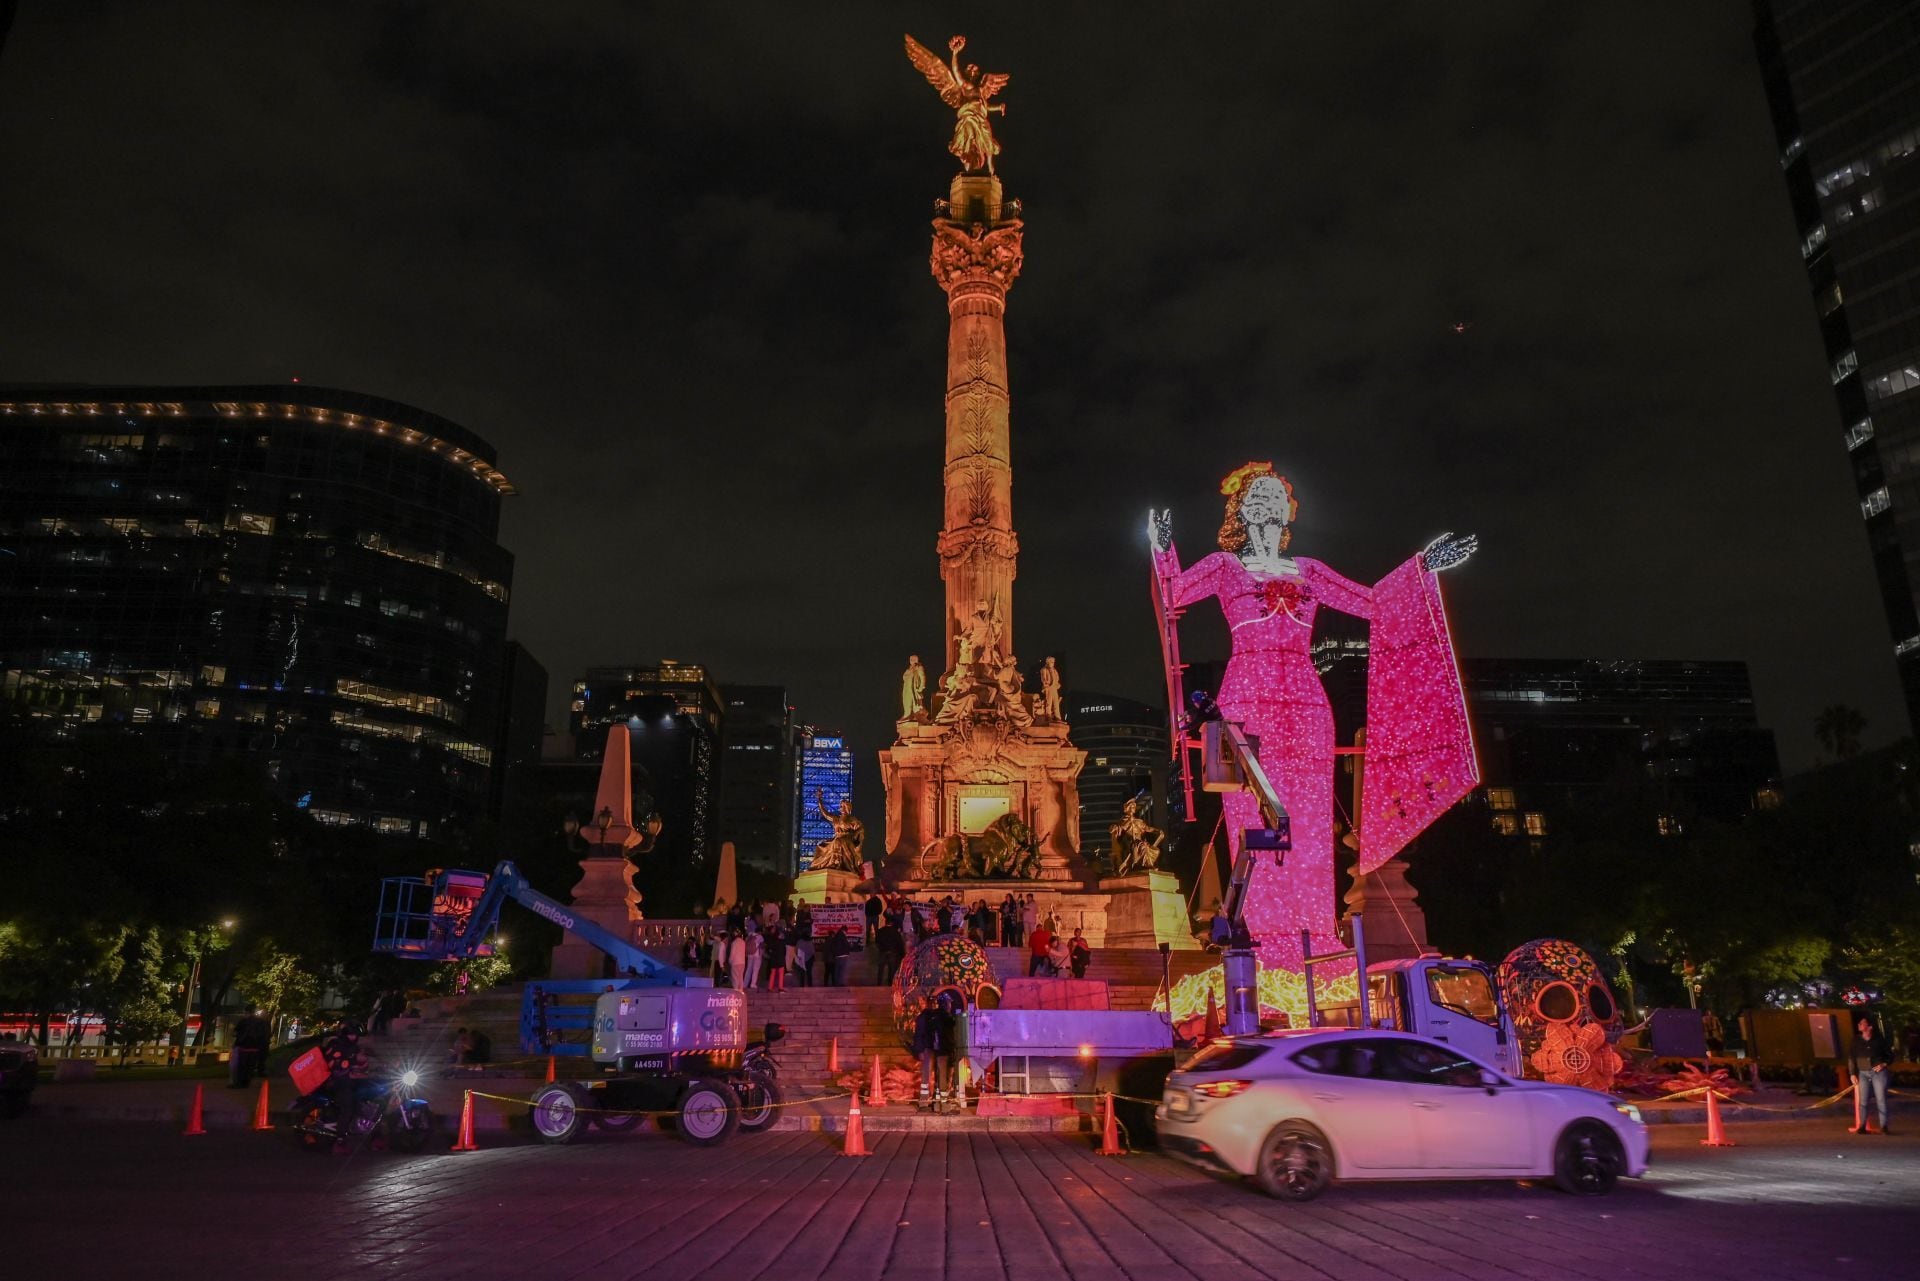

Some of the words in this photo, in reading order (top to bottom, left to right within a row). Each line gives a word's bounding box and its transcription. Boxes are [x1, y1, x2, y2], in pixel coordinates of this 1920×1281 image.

[813, 738, 842, 748] BBVA
[532, 900, 574, 929] mateco
[707, 995, 742, 1008] mateco
[625, 1032, 663, 1042] mateco
